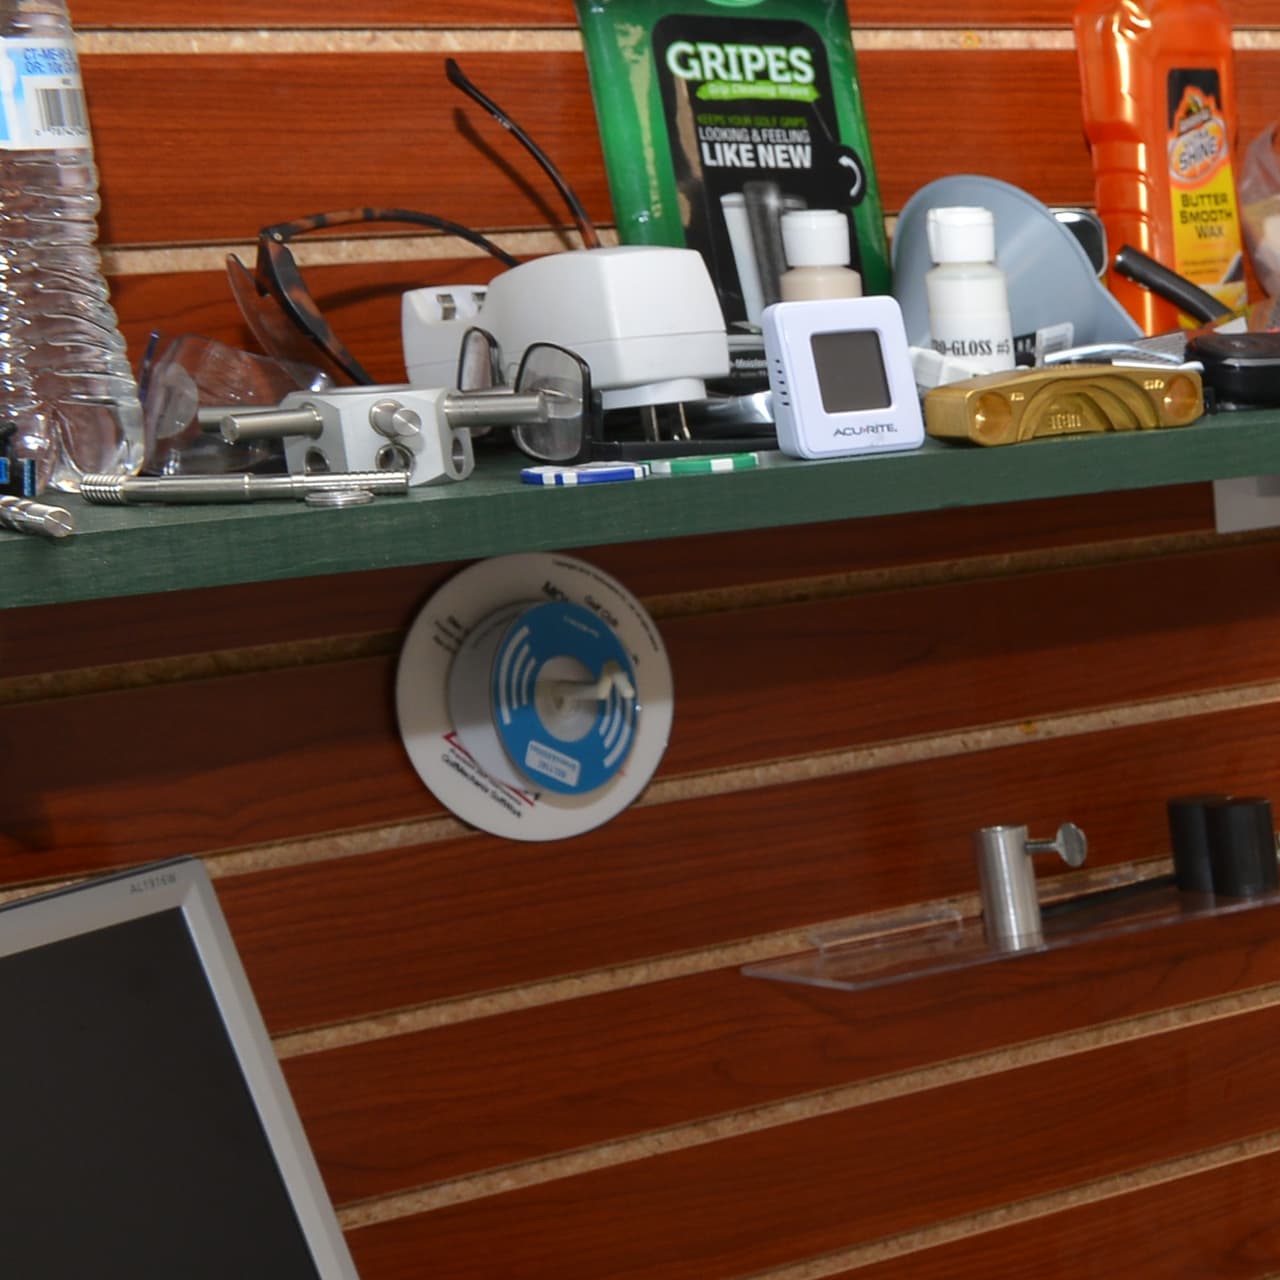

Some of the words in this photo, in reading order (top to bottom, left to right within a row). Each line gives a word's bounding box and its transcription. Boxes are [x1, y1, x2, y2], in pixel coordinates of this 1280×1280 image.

[665, 41, 815, 84] GRIPES
[699, 126, 750, 142] LOOKING
[762, 128, 811, 144] FEELING
[701, 142, 756, 167] LIKE
[757, 144, 812, 169] NEW
[1181, 192, 1229, 208] BUTTER
[1179, 208, 1233, 225] SMOOTH
[1195, 224, 1224, 240] WAX
